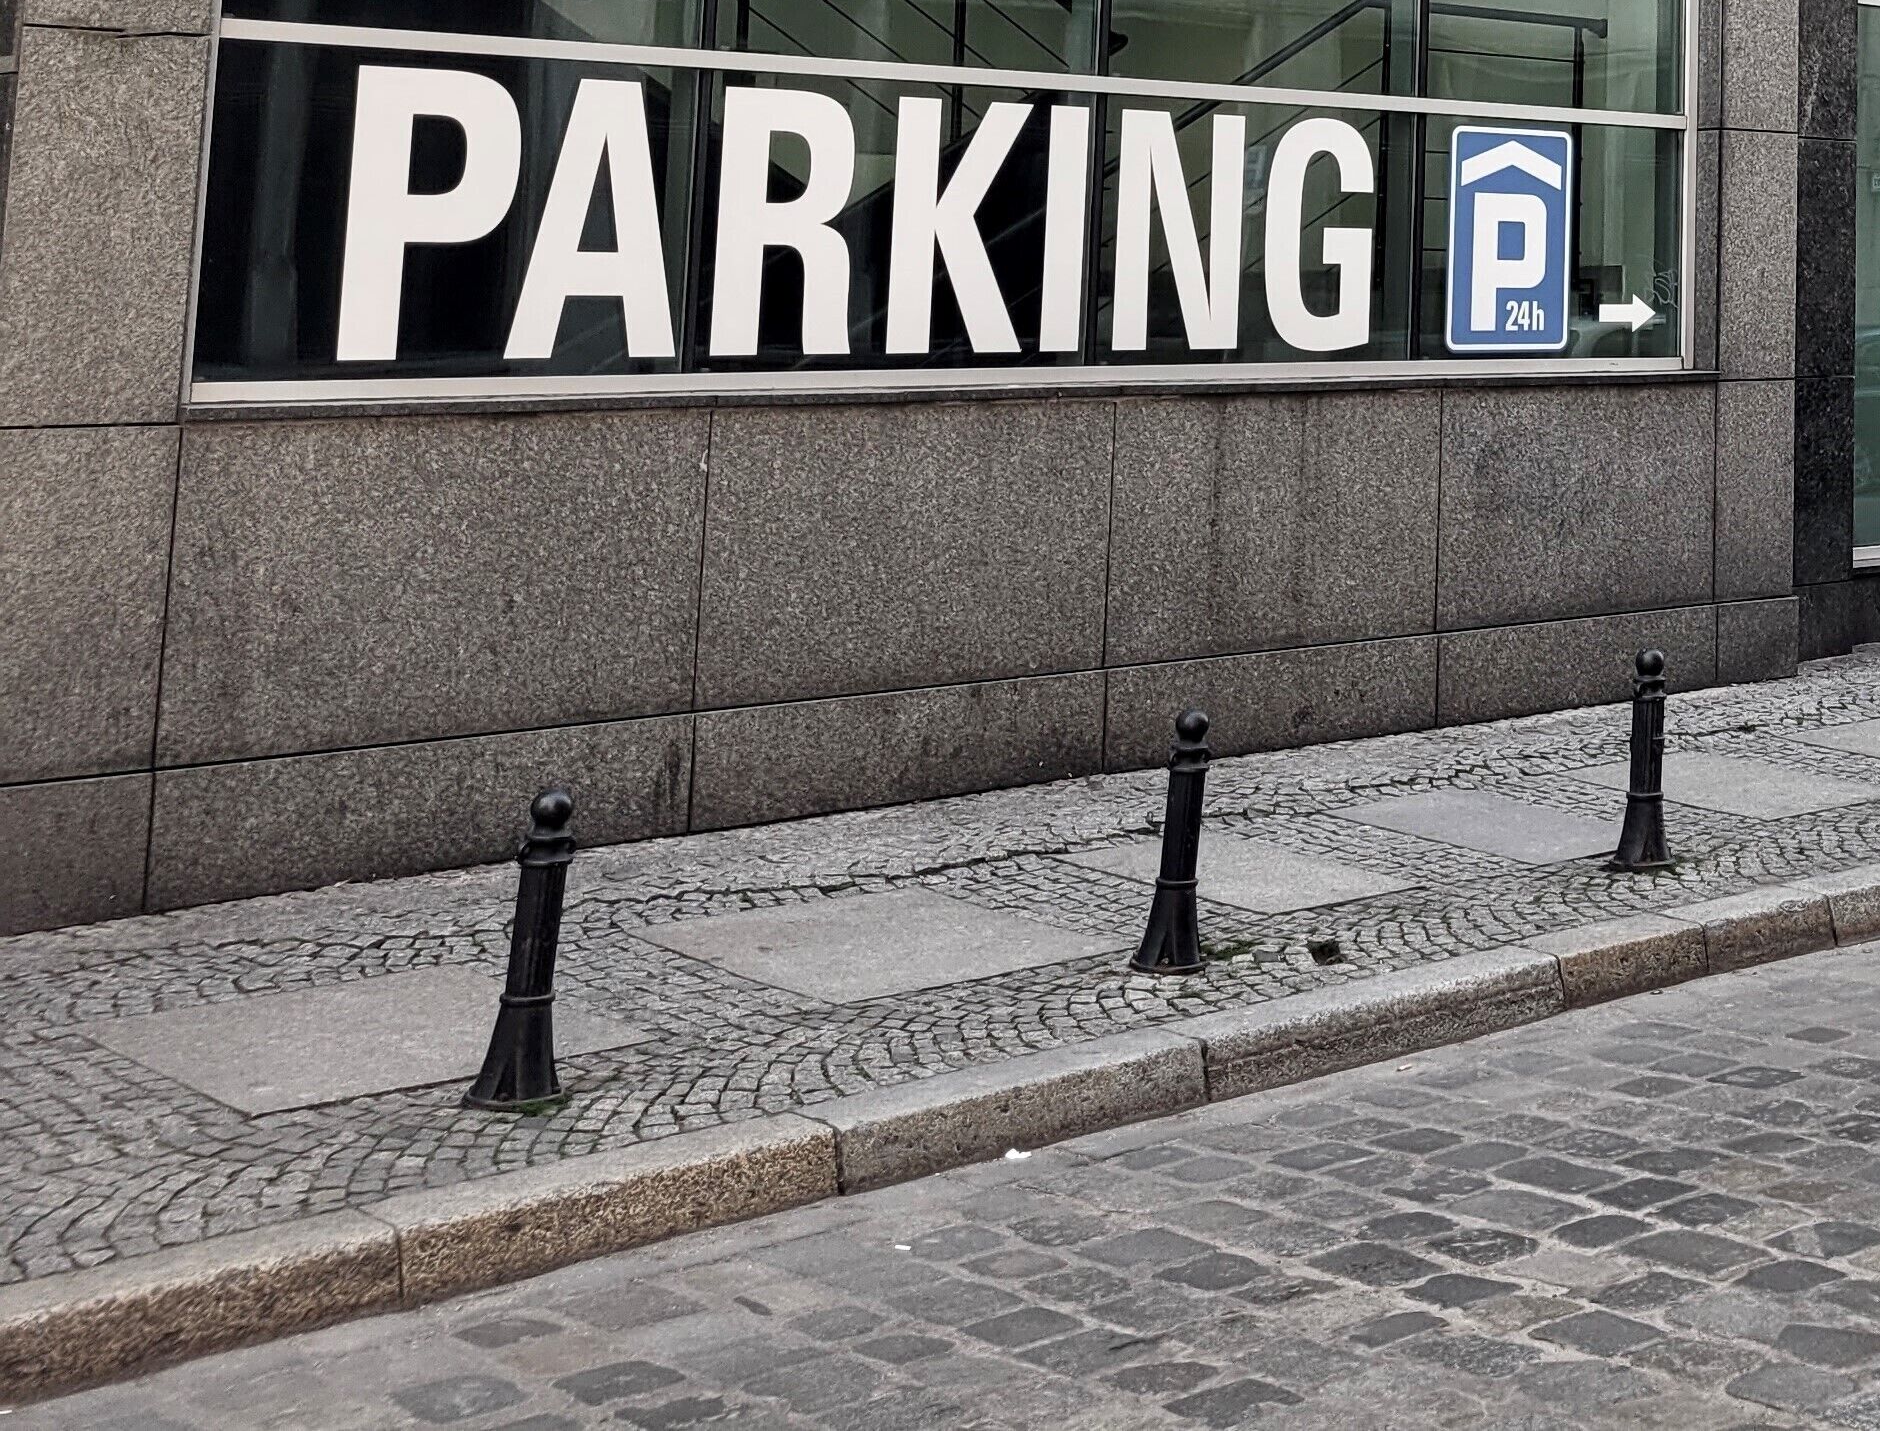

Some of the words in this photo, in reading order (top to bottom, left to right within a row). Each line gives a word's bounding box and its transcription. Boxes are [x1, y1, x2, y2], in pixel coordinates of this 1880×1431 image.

[337, 66, 1374, 361] PARKING
[1470, 192, 1548, 332] P
[1504, 300, 1545, 331] 24h
